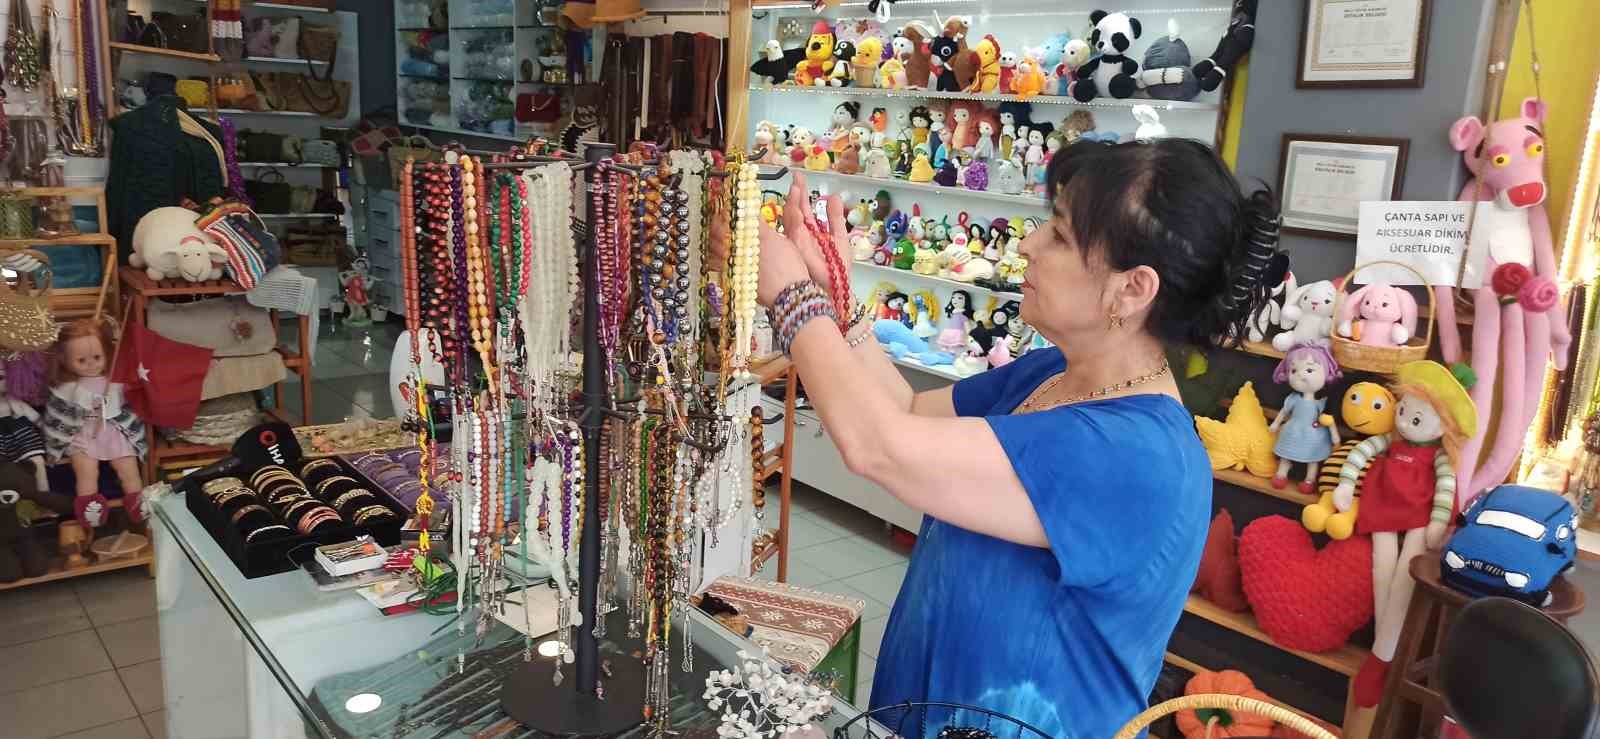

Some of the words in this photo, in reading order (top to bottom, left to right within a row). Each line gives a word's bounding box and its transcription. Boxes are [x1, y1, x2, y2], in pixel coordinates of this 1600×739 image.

[1384, 212, 1421, 223] ÇANTA
[1424, 213, 1448, 222] SAPI
[1452, 214, 1465, 223] VE
[1376, 228, 1432, 238] AKSESUAR
[1390, 242, 1455, 255] ÜCRETLİDİR.
